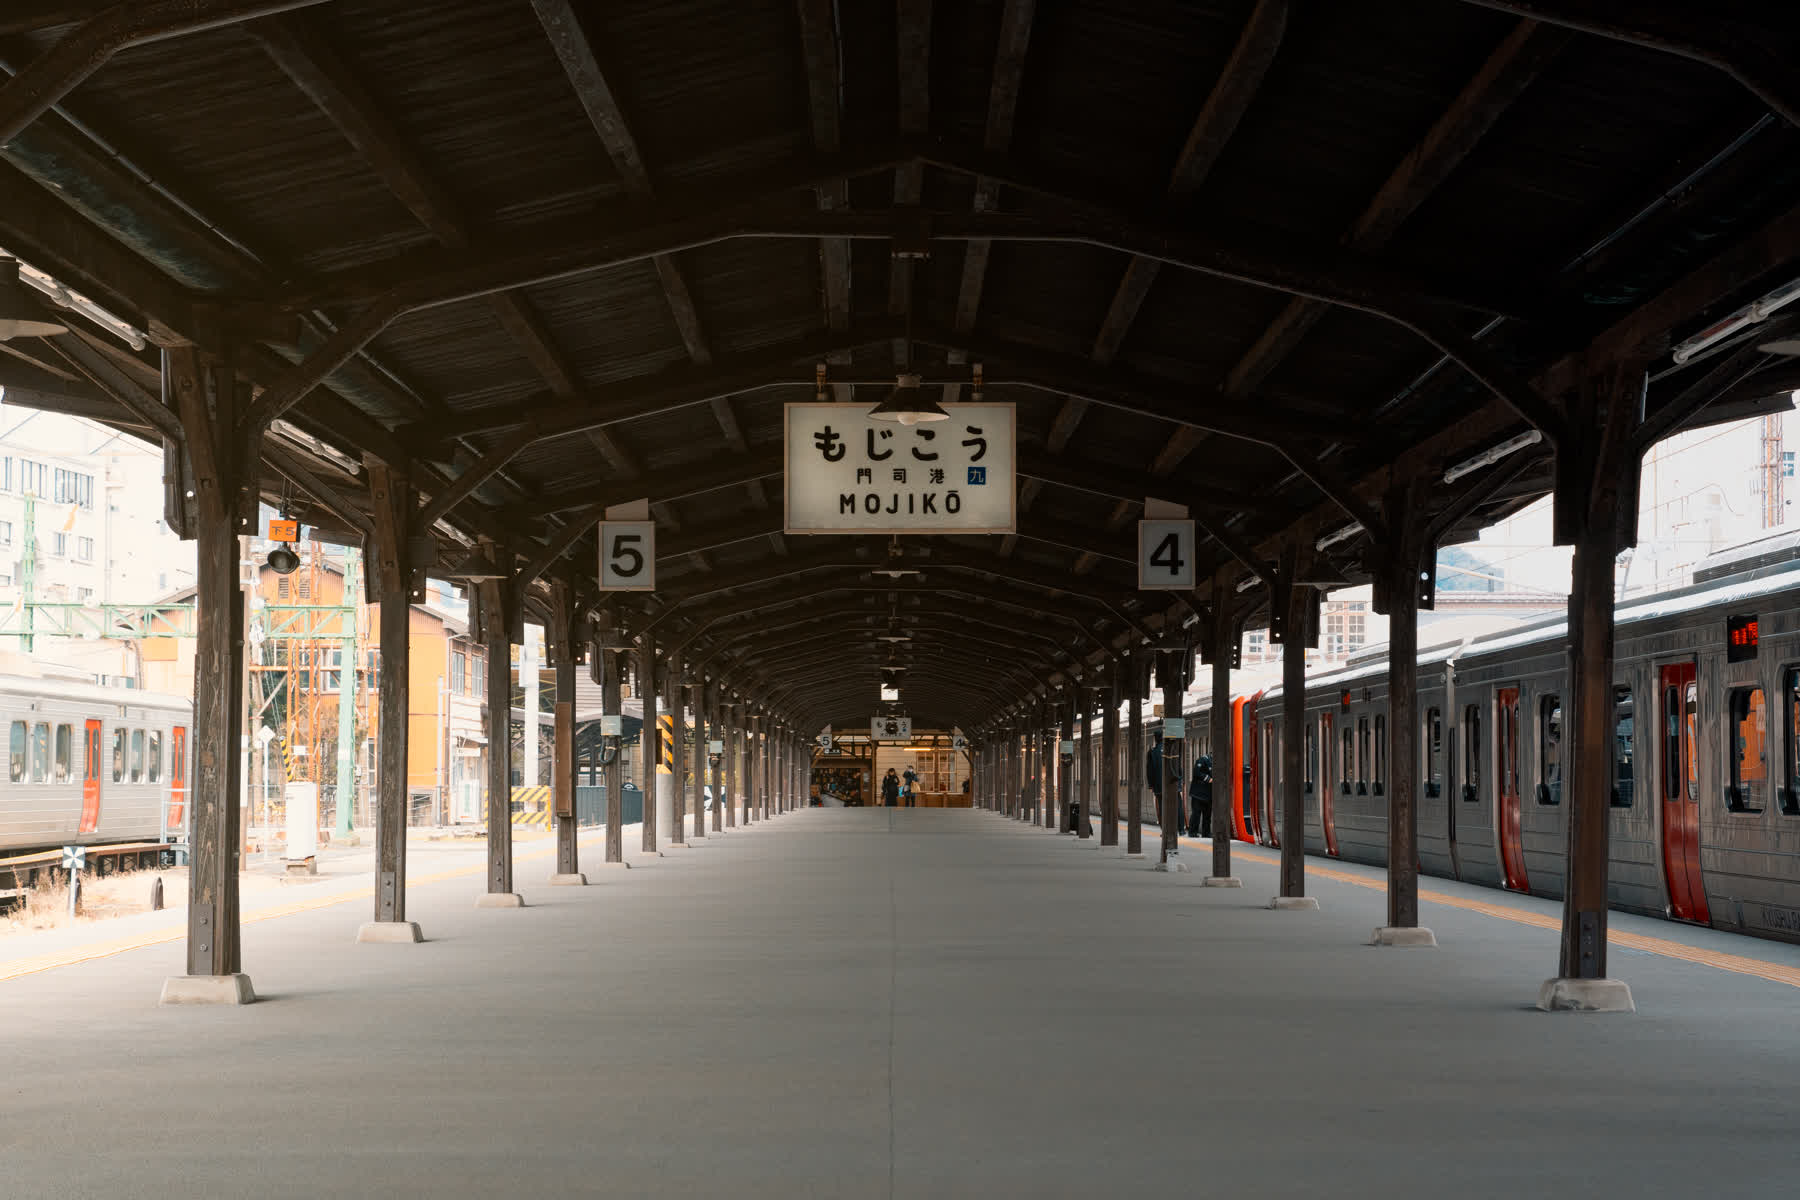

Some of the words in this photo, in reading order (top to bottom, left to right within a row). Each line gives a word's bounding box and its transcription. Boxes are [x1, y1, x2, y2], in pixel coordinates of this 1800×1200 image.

[813, 425, 987, 462] もじこう
[857, 468, 945, 484] 門司港
[610, 535, 644, 577] 5
[1150, 533, 1184, 576] 4
[822, 736, 830, 746] 5
[955, 738, 964, 748] 4
